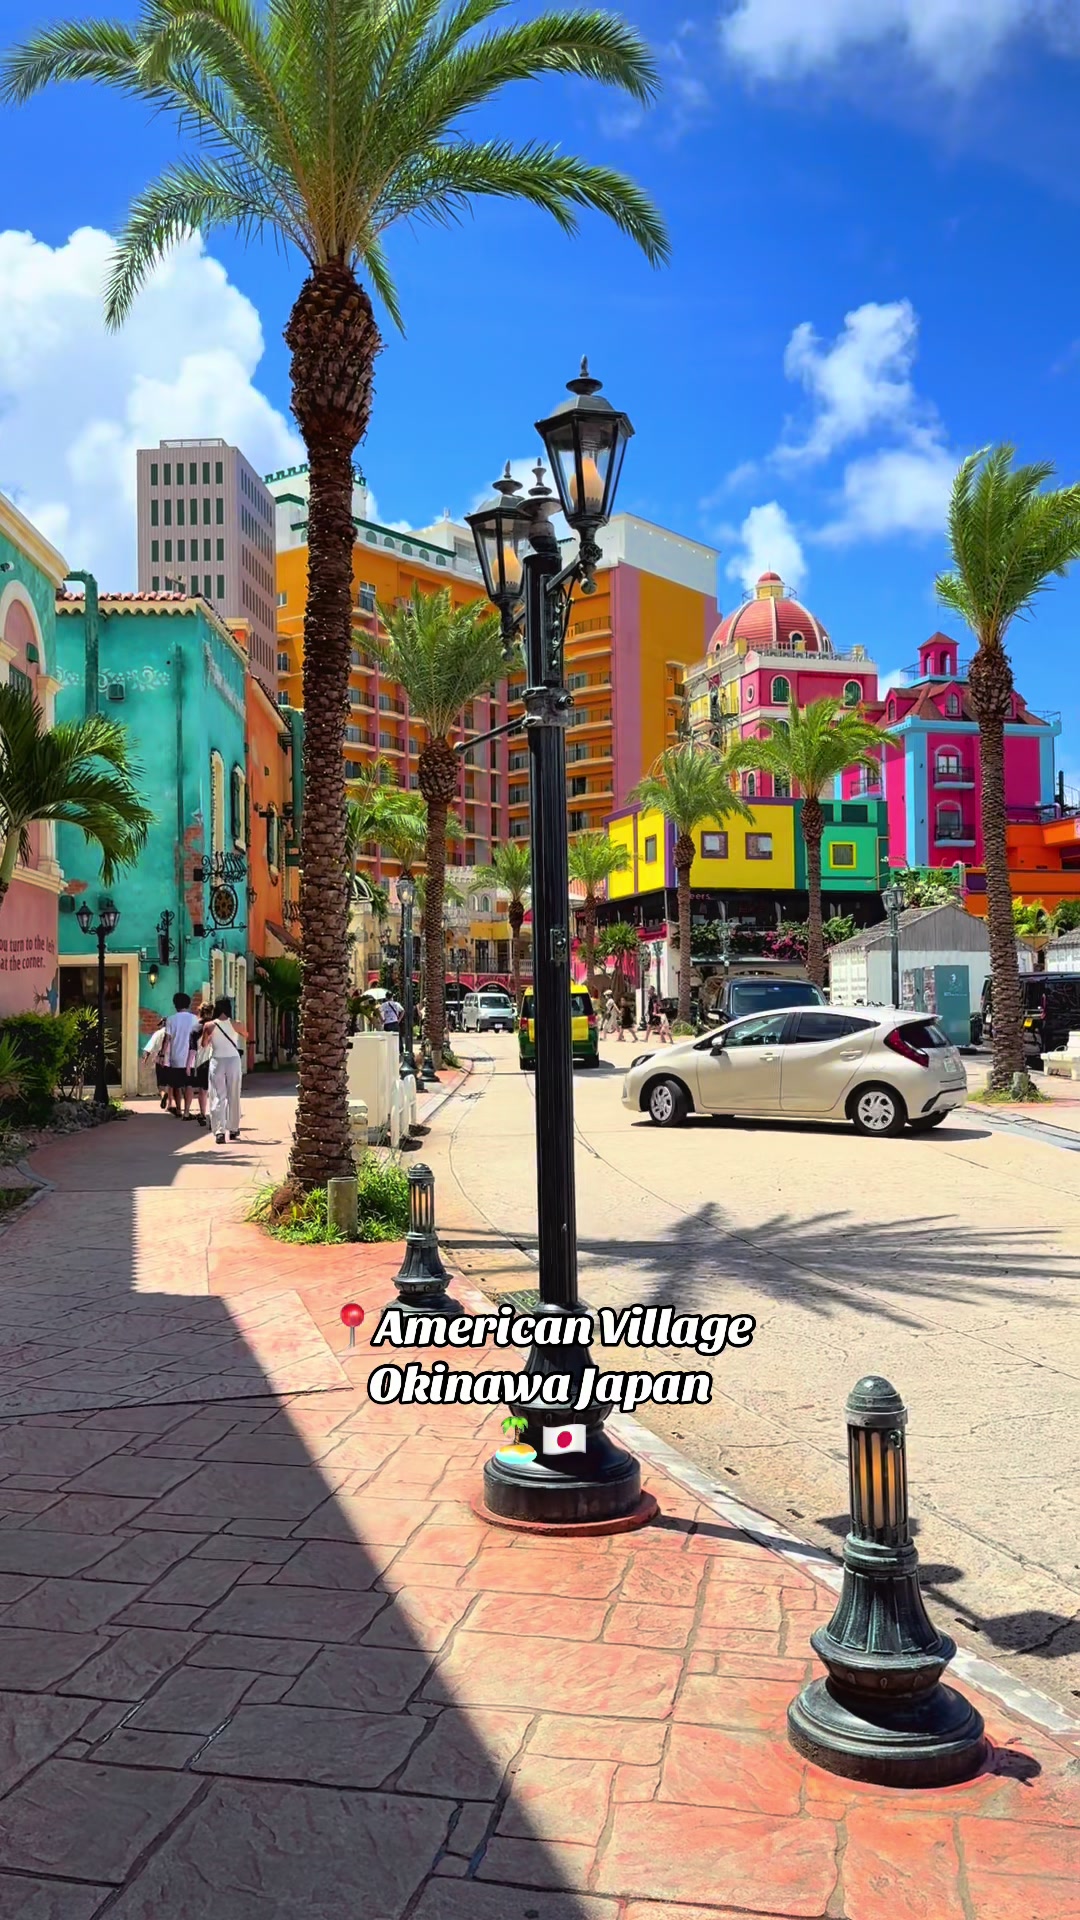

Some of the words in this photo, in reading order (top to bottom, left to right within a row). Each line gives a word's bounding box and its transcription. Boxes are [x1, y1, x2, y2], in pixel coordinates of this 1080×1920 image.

[0, 939, 8, 952] ou
[10, 938, 24, 952] turn
[26, 936, 33, 951] to
[35, 934, 44, 951] the
[0, 957, 8, 971] at
[10, 955, 20, 971] the
[22, 956, 46, 969] corner.
